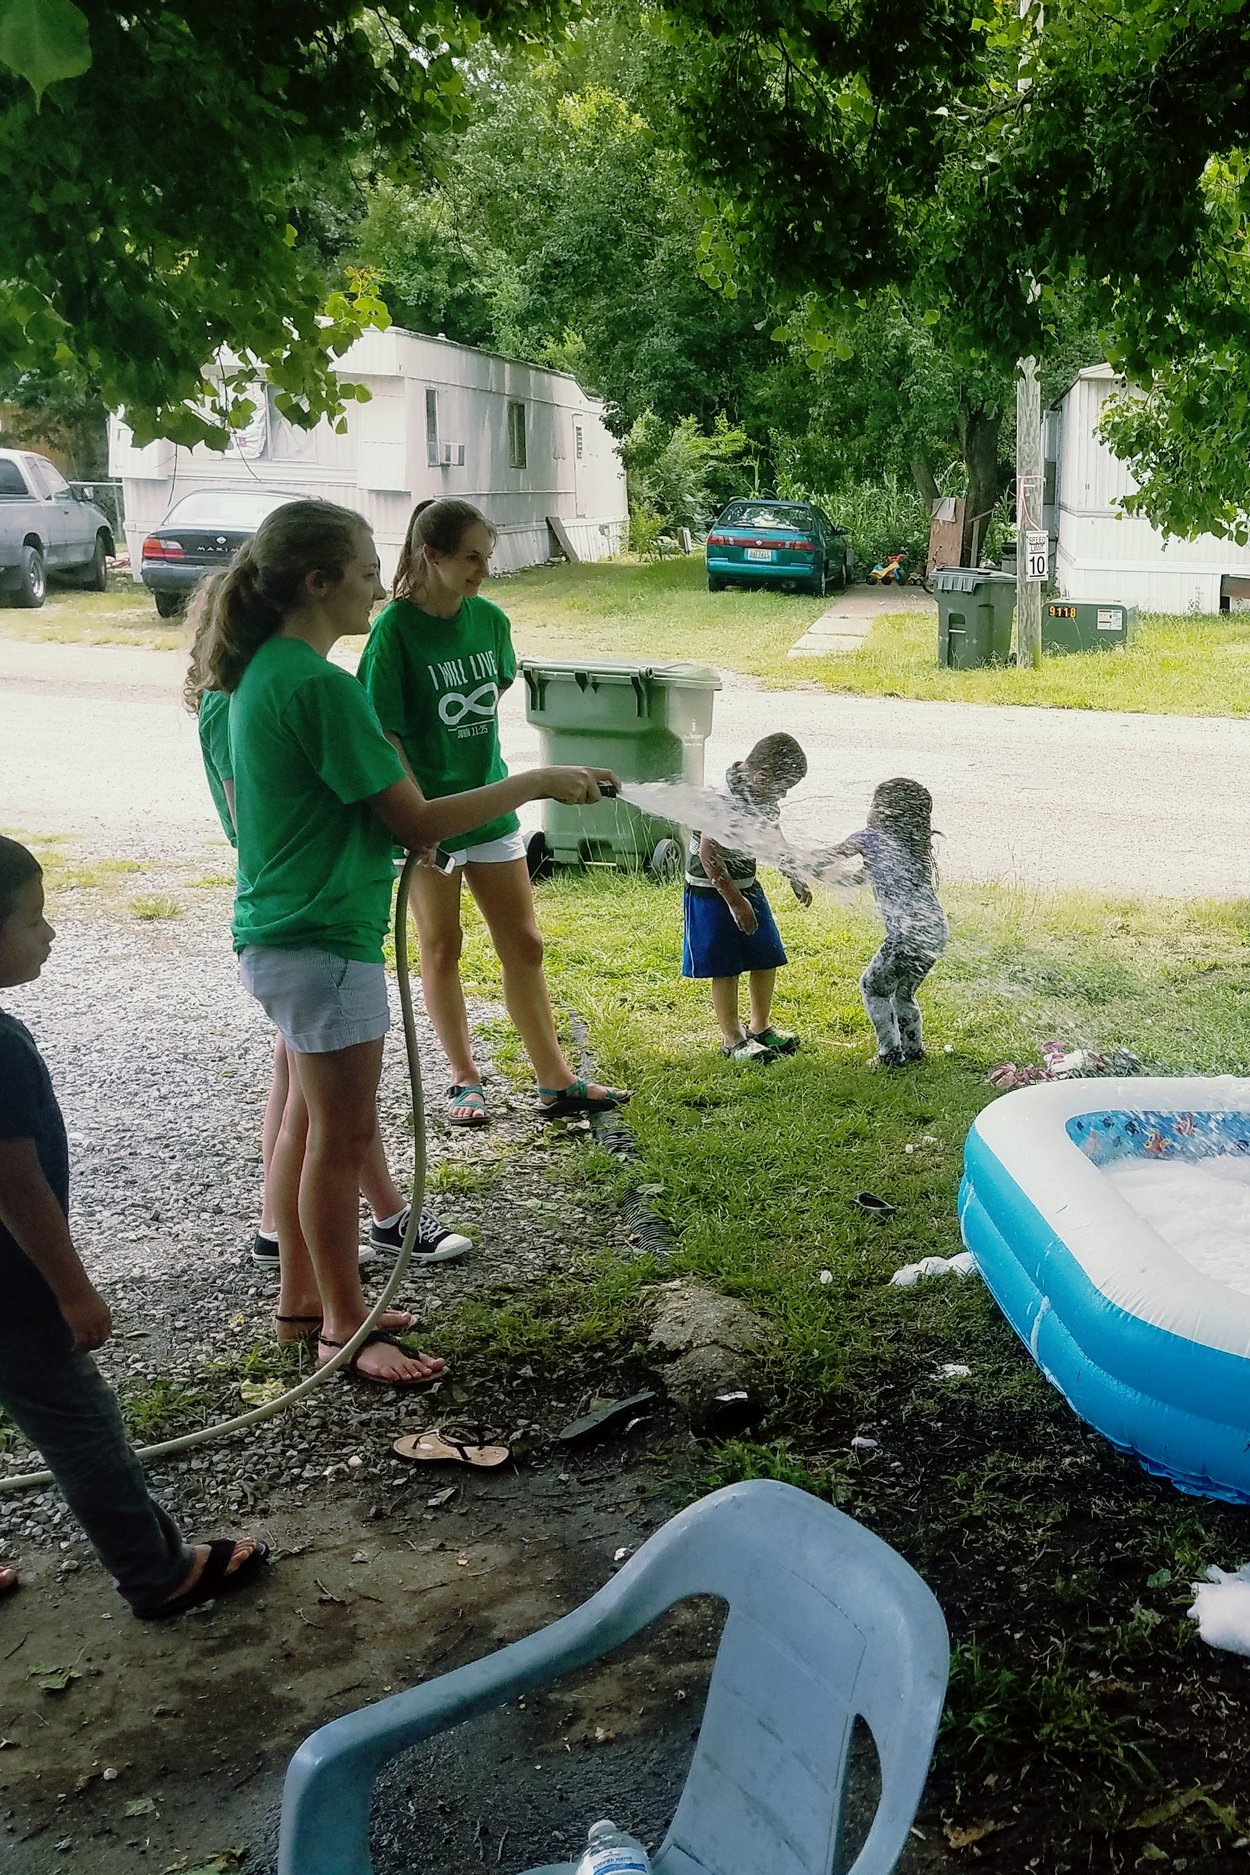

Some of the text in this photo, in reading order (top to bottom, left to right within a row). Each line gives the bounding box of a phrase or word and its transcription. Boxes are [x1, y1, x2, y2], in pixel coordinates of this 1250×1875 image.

[1029, 556, 1045, 575] 10
[1049, 606, 1076, 618] 9118
[427, 650, 498, 691] I WILL LIVE
[457, 724, 489, 739] JOHN 11:25
